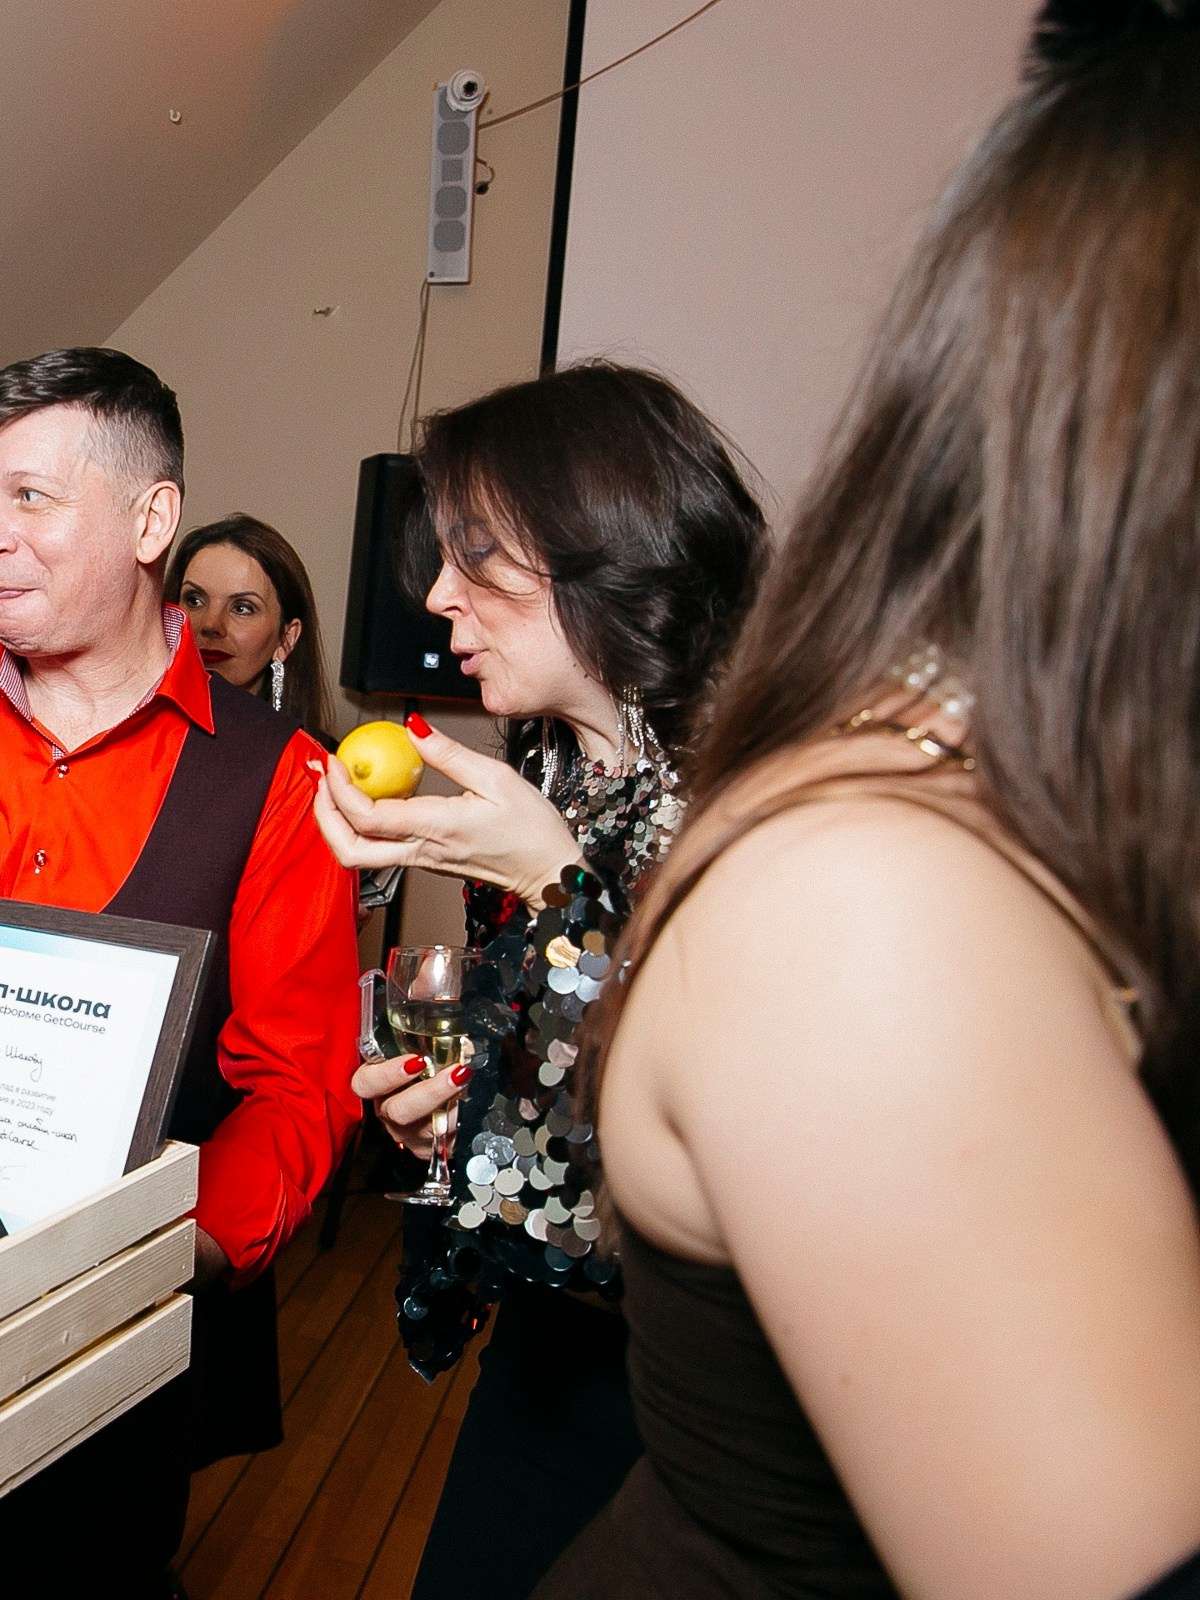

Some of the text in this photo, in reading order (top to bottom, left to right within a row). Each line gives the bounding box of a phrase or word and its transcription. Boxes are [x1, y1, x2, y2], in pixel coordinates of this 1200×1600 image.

[43, 1013, 106, 1035] GetCourse
[21, 1087, 56, 1102] развитие
[16, 1098, 36, 1111] 2023
[36, 1105, 55, 1117] году
